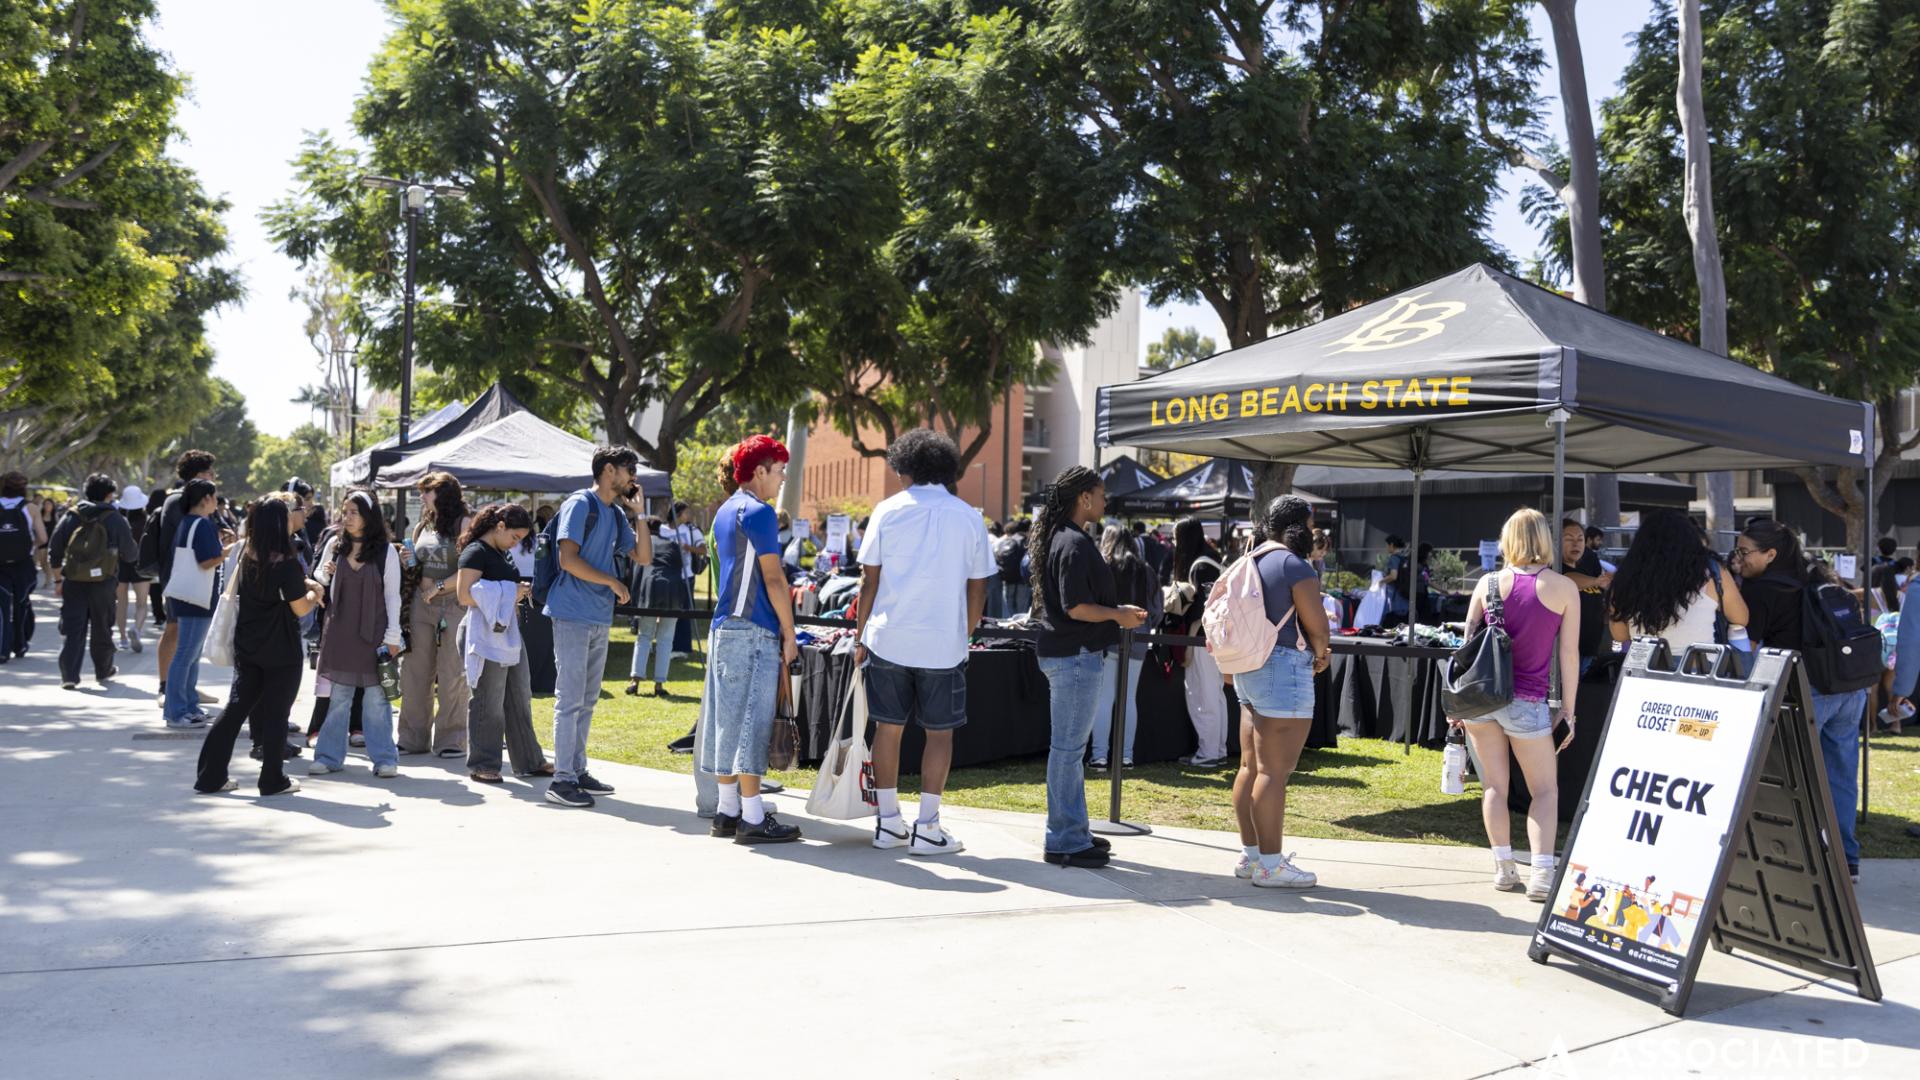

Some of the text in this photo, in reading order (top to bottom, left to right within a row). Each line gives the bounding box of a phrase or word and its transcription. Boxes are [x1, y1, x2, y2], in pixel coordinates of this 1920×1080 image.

[1151, 376, 1472, 427] LONG BEACH STATE
[1637, 714, 1676, 733] CLOSET
[1640, 701, 1719, 722] CAREER CLOTHING
[1610, 767, 1715, 816] CHECK
[1626, 809, 1664, 846] IN
